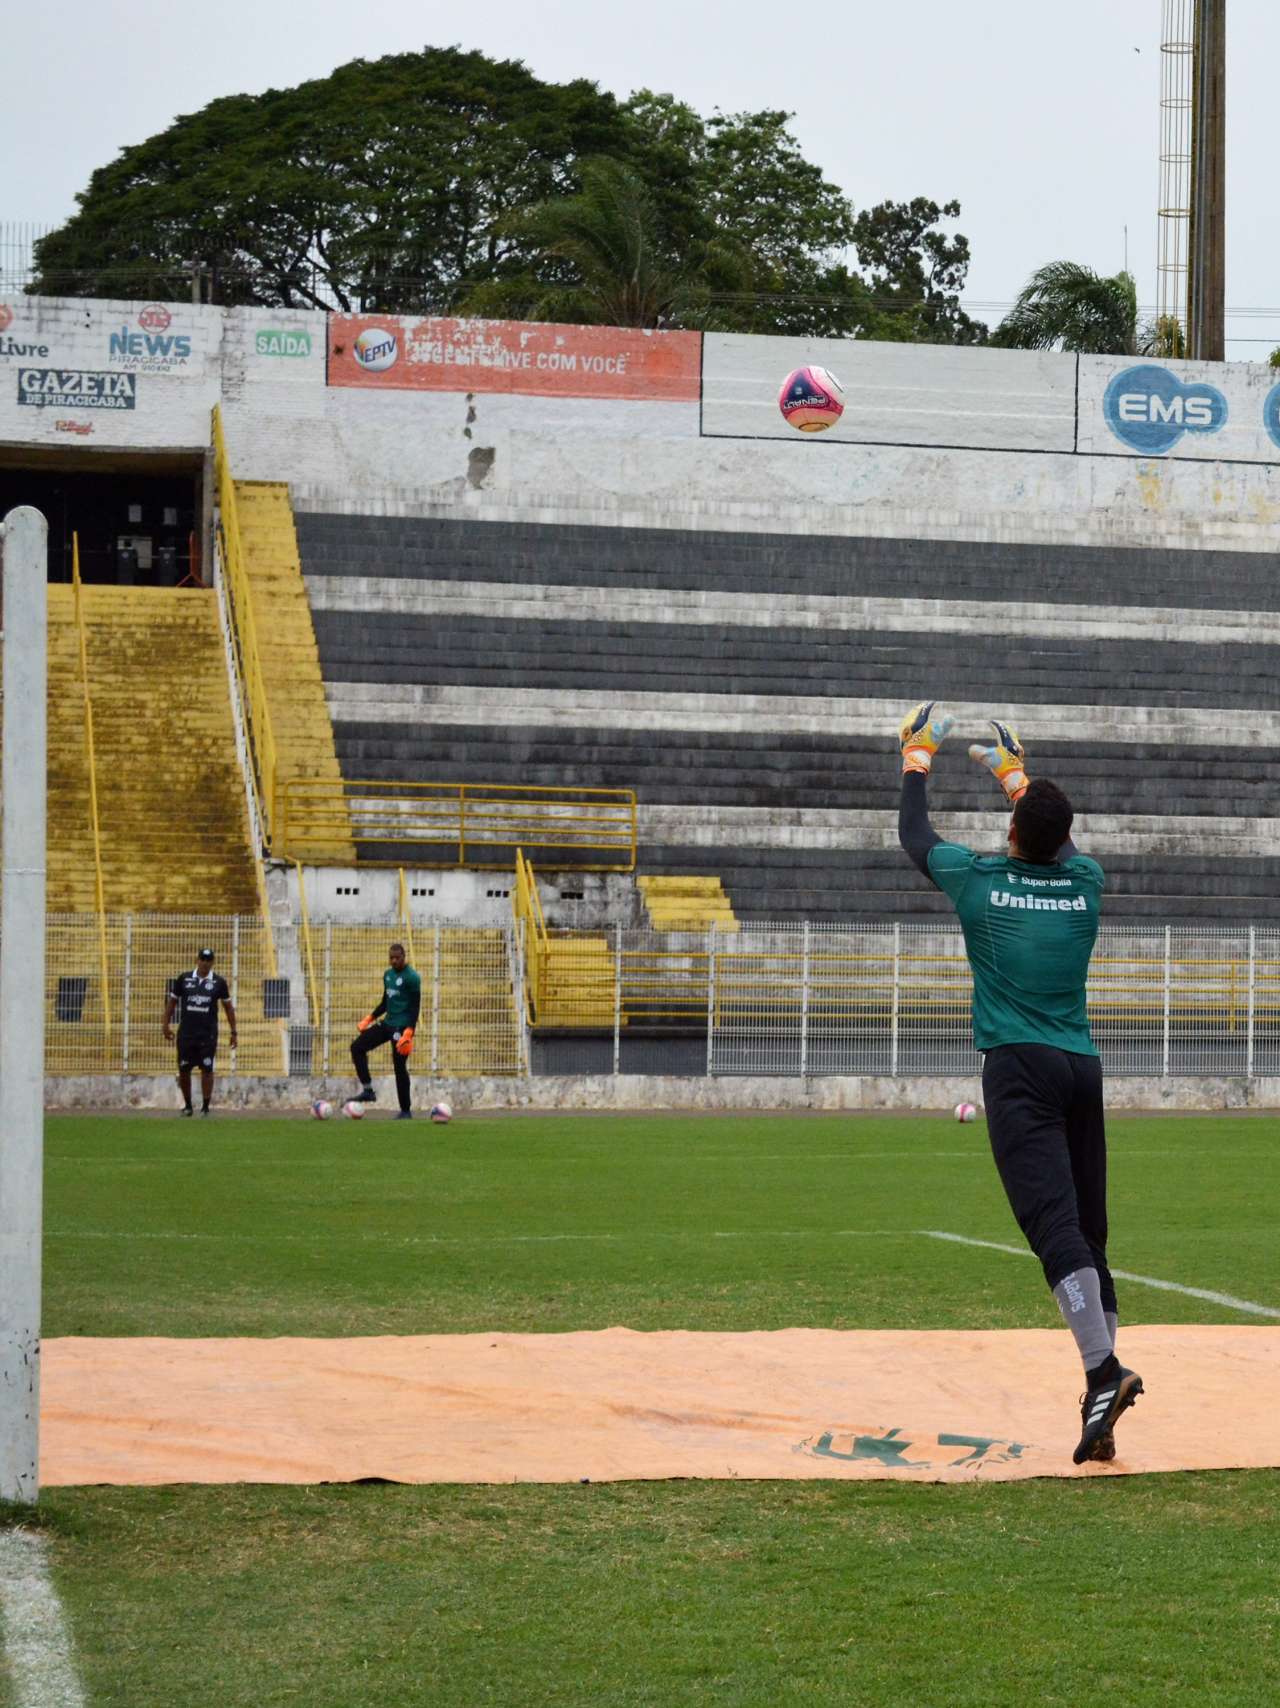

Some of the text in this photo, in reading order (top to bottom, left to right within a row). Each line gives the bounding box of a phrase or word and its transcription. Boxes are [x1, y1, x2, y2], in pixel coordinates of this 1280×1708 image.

[0, 336, 49, 358] Livre
[110, 326, 191, 357] NEWS
[258, 333, 308, 355] SAÍDA
[109, 355, 187, 366] PIRACICABA
[537, 352, 577, 371] COM
[582, 354, 626, 375] VOCÊ
[20, 370, 134, 397] GAZETA
[26, 393, 127, 408] DE PIRACICABA
[1118, 393, 1213, 425] EMS
[990, 890, 1088, 911] Unimed
